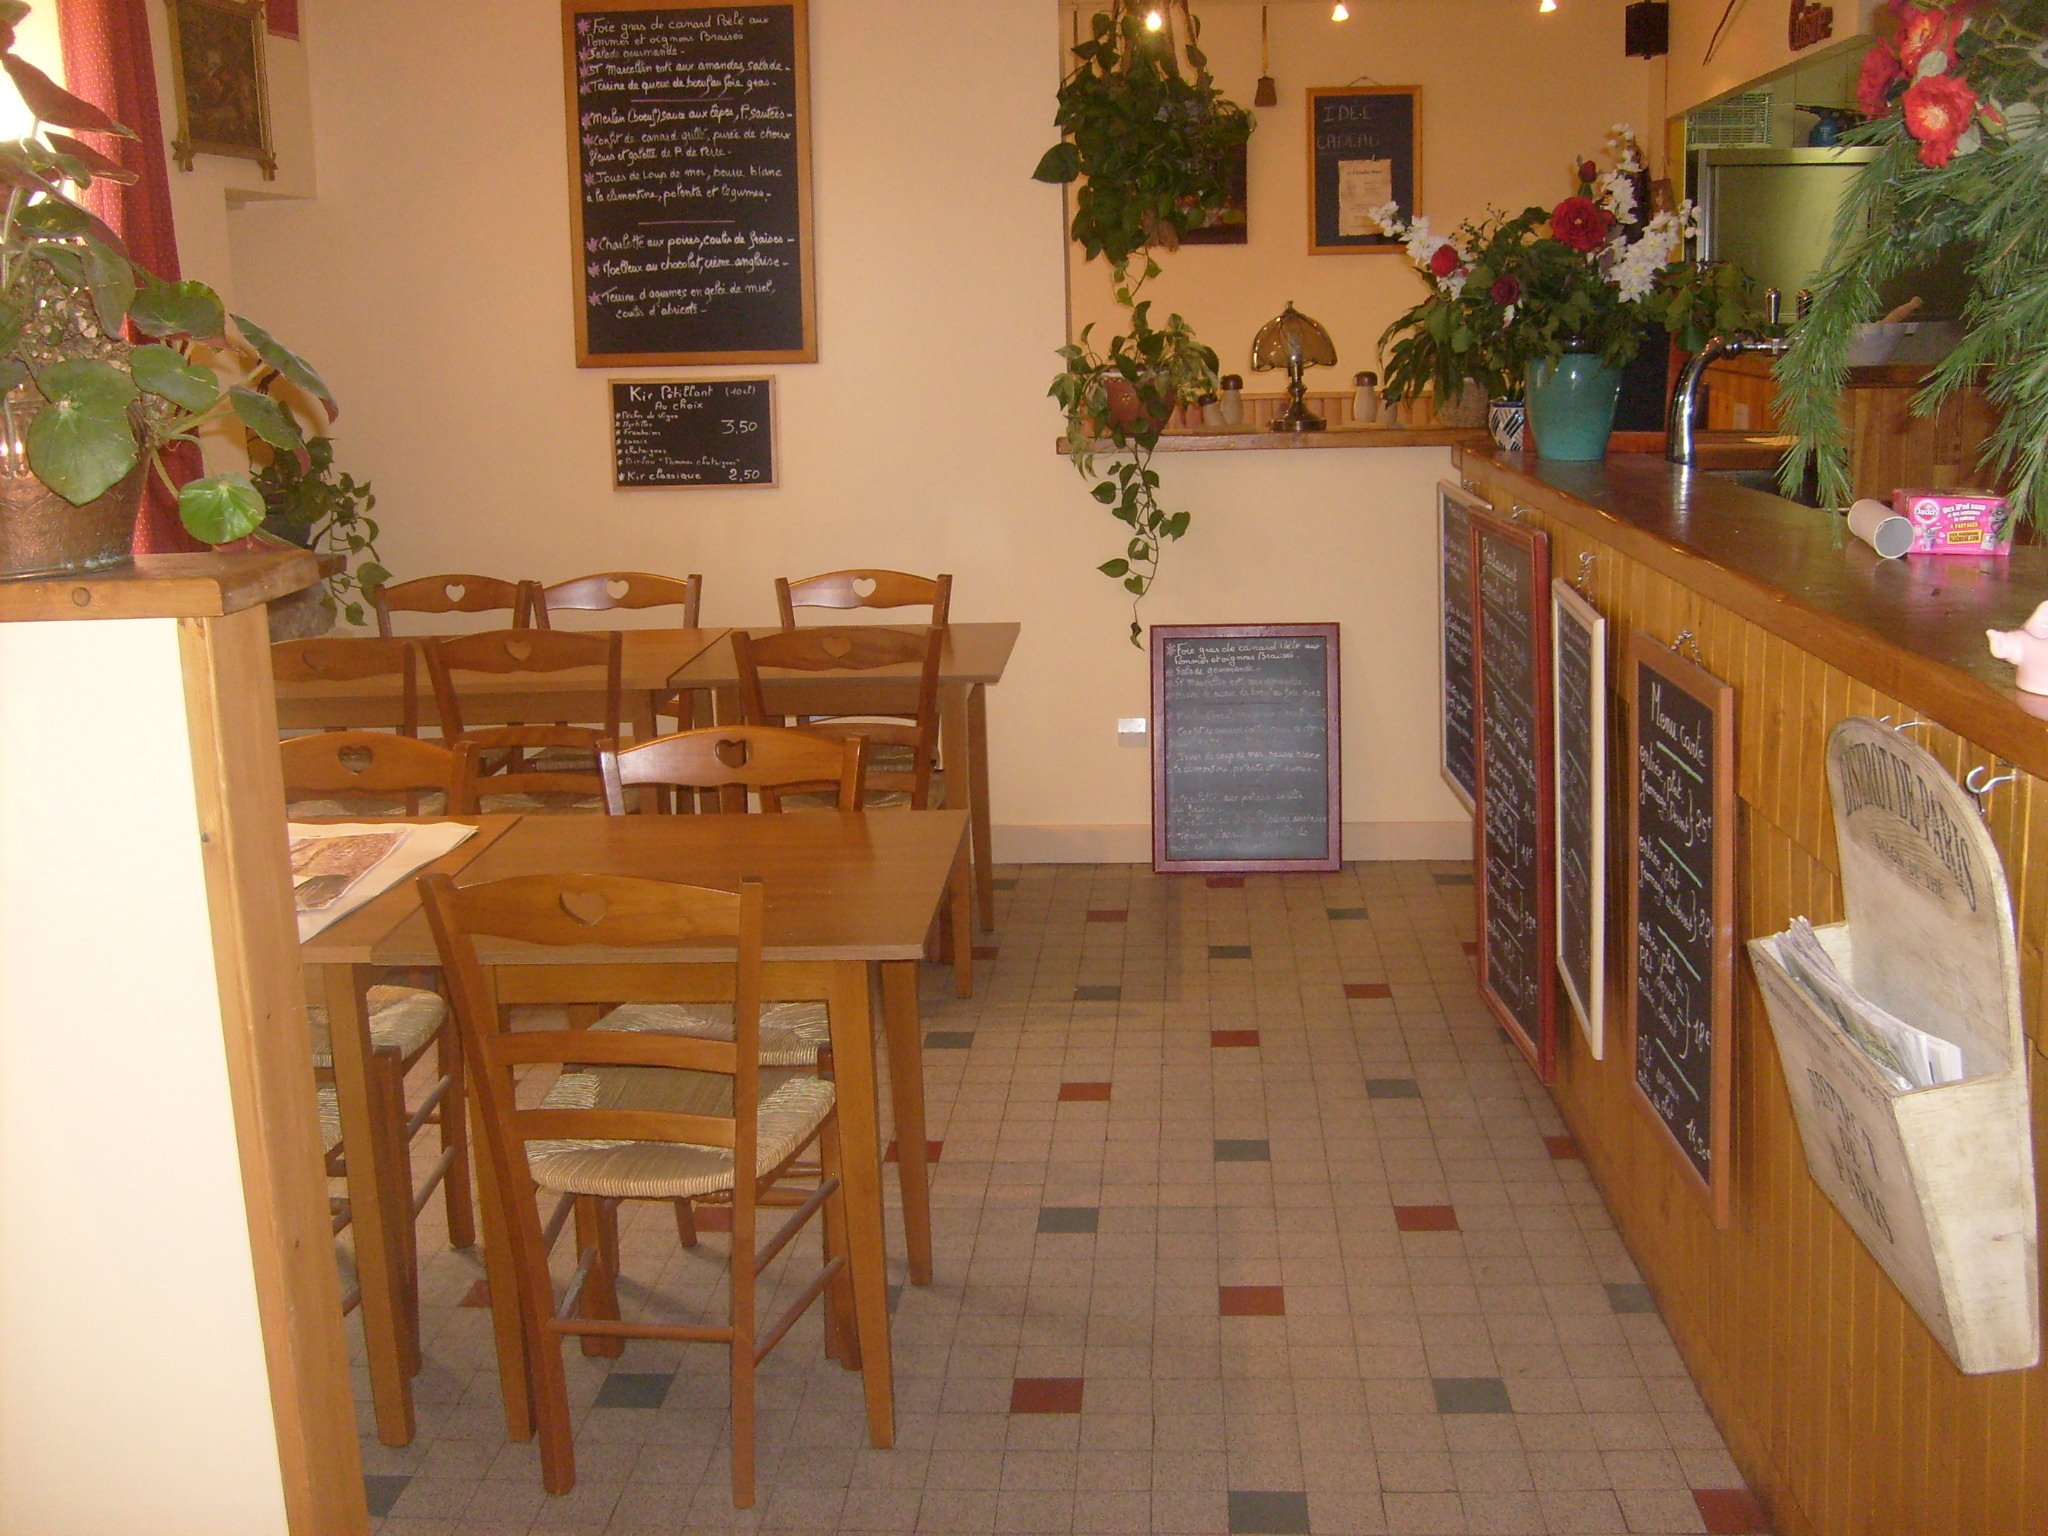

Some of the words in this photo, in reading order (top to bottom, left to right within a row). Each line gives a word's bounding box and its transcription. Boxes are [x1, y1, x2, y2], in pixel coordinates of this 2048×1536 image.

[593, 17, 616, 34] Foie
[621, 22, 646, 39] gras
[651, 16, 664, 30] de
[668, 15, 711, 30] canard
[749, 17, 769, 25] aux
[587, 35, 630, 48] Pommes
[635, 35, 647, 46] et
[650, 34, 694, 49] oignons
[588, 48, 621, 60] Salade
[676, 62, 694, 72] aux
[627, 78, 641, 91] de
[672, 76, 685, 89] de
[688, 109, 708, 120] aux
[624, 132, 637, 145] de
[641, 131, 677, 143] canard
[743, 127, 757, 140] de
[760, 126, 791, 140] choux
[661, 148, 672, 159] de
[686, 147, 698, 158] de
[629, 171, 641, 182] de
[670, 168, 681, 179] de
[750, 165, 783, 178] blanc
[595, 192, 605, 203] la
[706, 184, 719, 199] et
[599, 233, 645, 251] Charlotte
[647, 239, 664, 248] aux
[733, 232, 746, 244] de
[748, 231, 783, 250] fraises
[603, 257, 642, 277] Moelleux
[645, 262, 658, 272] au
[734, 251, 780, 273] anglaise
[690, 288, 701, 297] en
[730, 283, 743, 294] de
[630, 386, 653, 402] Kir
[655, 401, 667, 410] Au
[673, 399, 703, 410] choix
[627, 471, 645, 481] Kir
[650, 468, 702, 480] classique
[1914, 507, 1938, 516] Daddy
[1177, 643, 1195, 656] Foie
[1199, 646, 1220, 660] gras
[1222, 642, 1235, 653] de
[1238, 643, 1276, 653] canard
[1174, 655, 1208, 665] Pommes
[1211, 656, 1221, 664] et
[1651, 681, 1677, 741] Menu
[1838, 742, 1893, 817] BISTROT
[1890, 752, 1920, 833] DE
[1916, 774, 1977, 912] PARIS
[1828, 1138, 1894, 1244] PARIS
